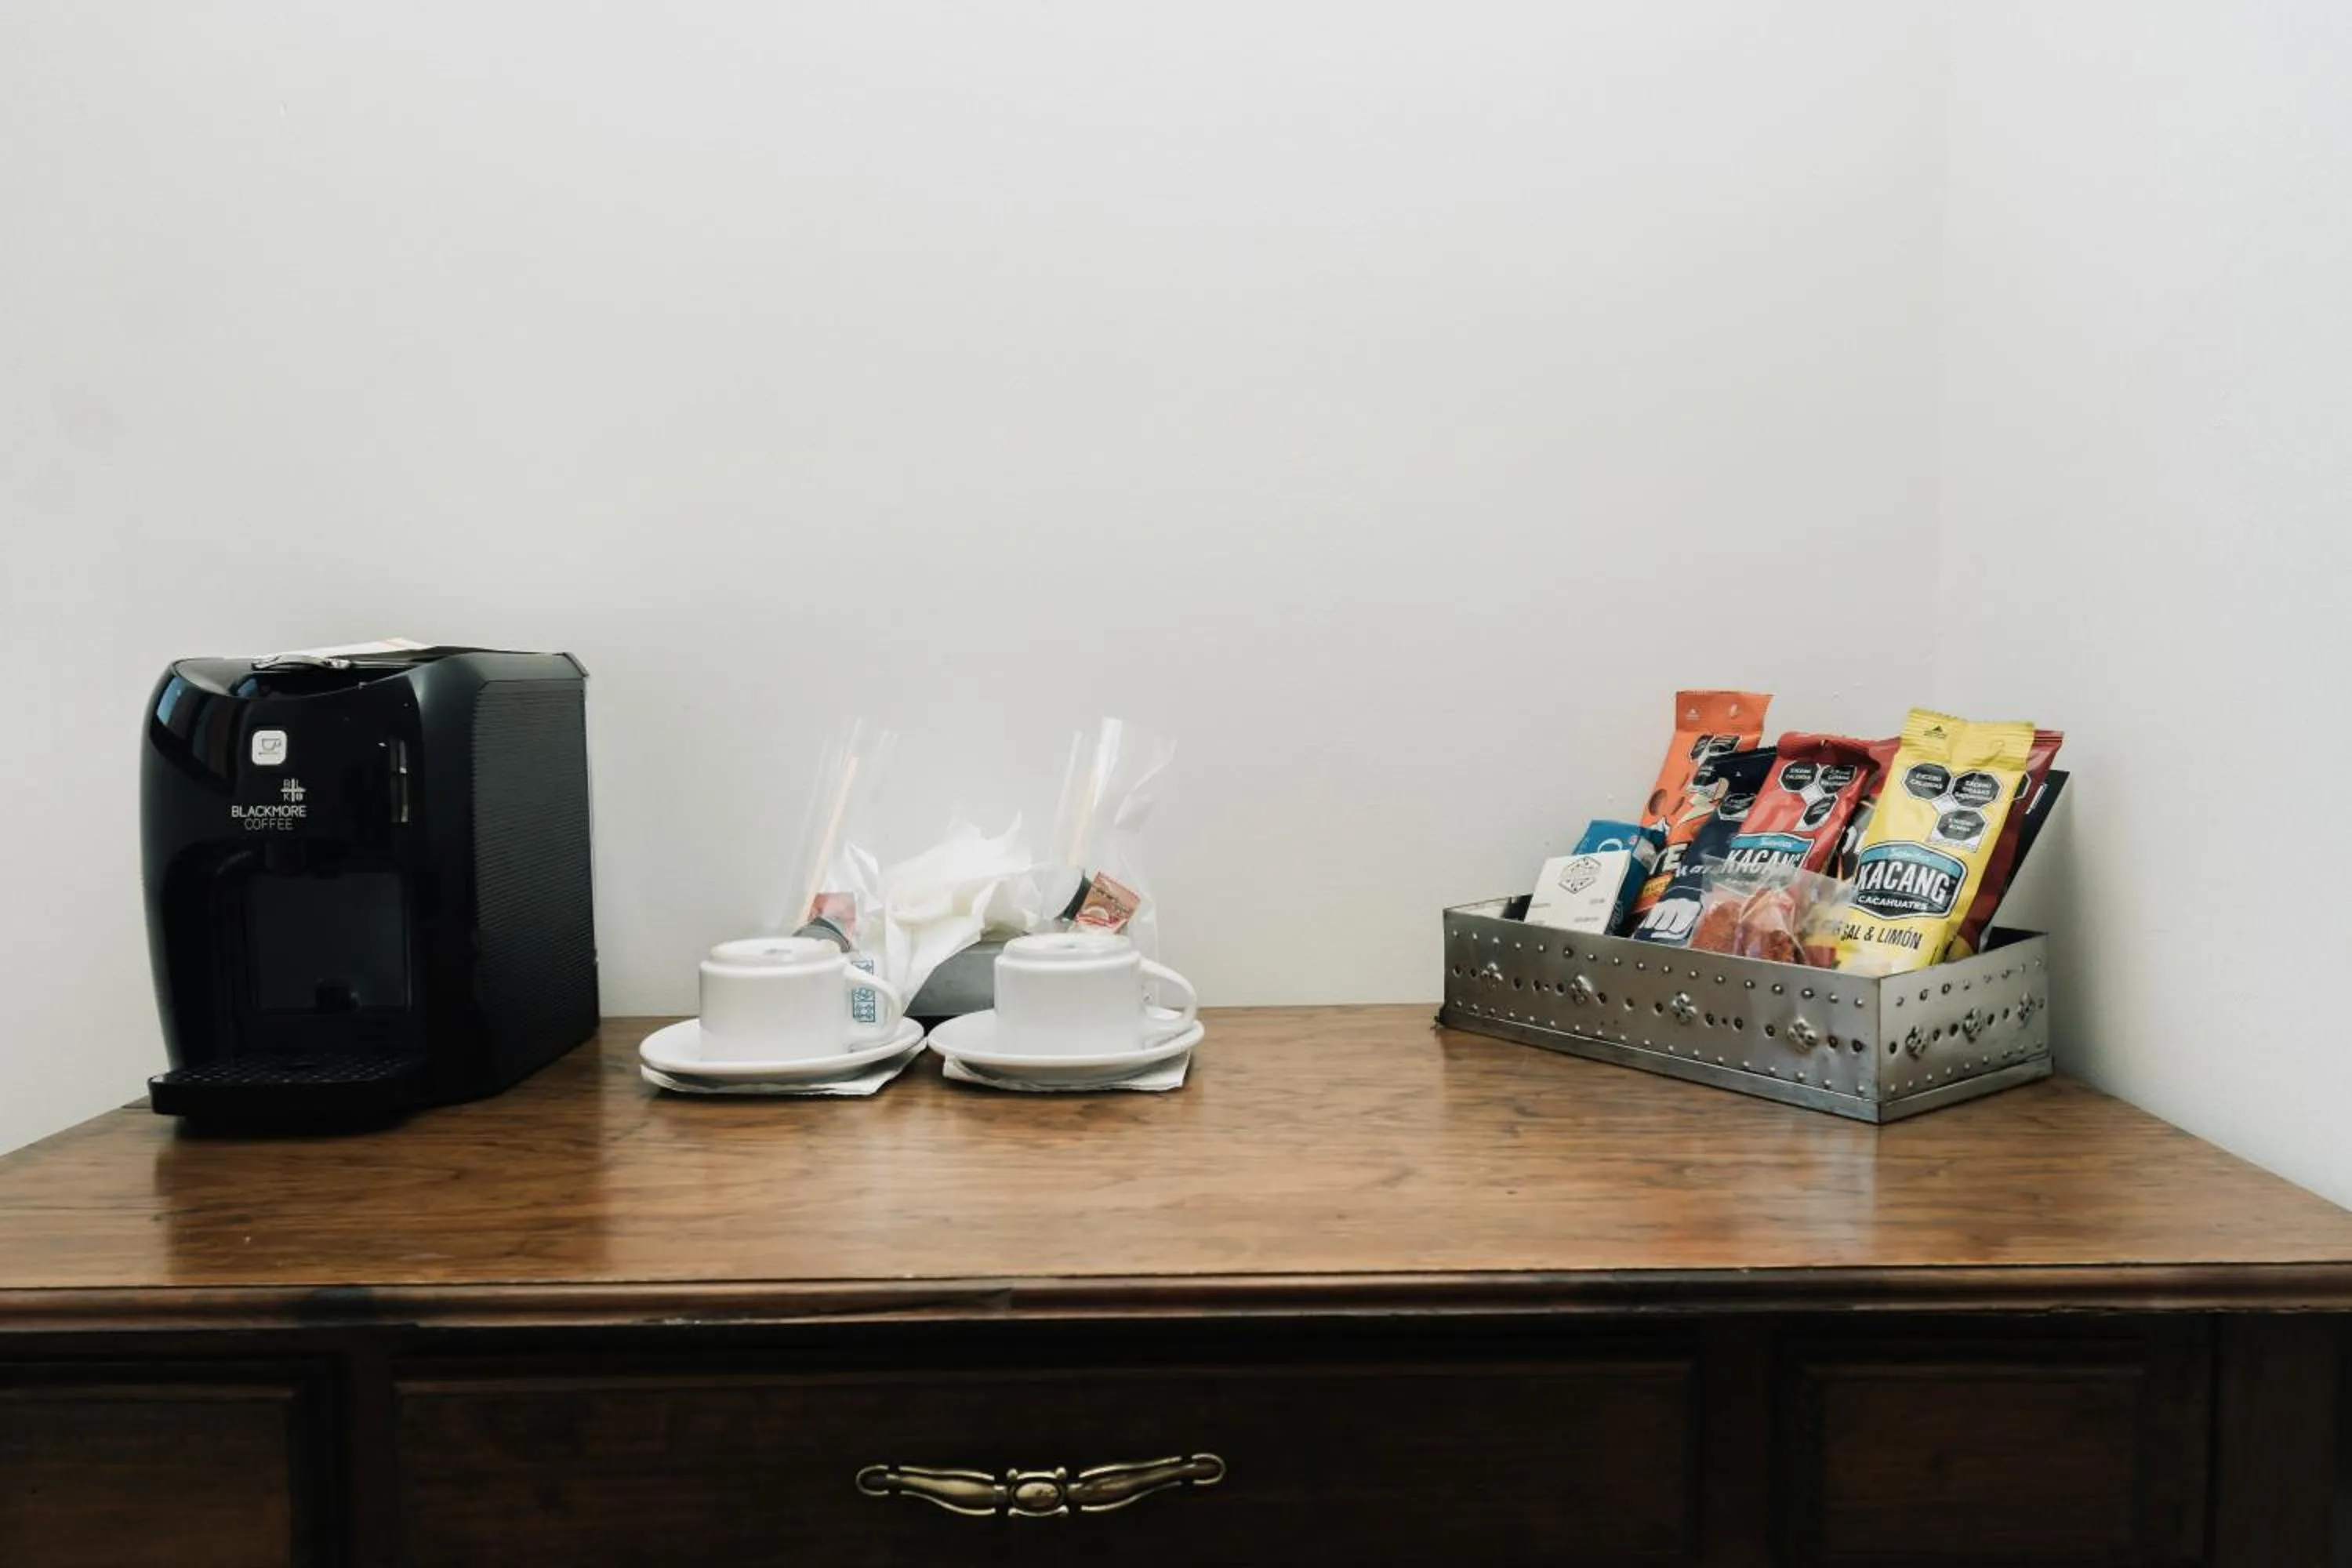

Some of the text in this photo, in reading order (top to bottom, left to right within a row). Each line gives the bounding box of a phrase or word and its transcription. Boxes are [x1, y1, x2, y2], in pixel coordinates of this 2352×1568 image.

[231, 805, 307, 818] BLACKMORE
[244, 818, 294, 831] COFFEE
[1857, 860, 1950, 905] KACANG
[1857, 895, 1928, 911] CACAHUATES
[1864, 926, 1875, 942] &
[1876, 925, 1923, 950] LIMÓN
